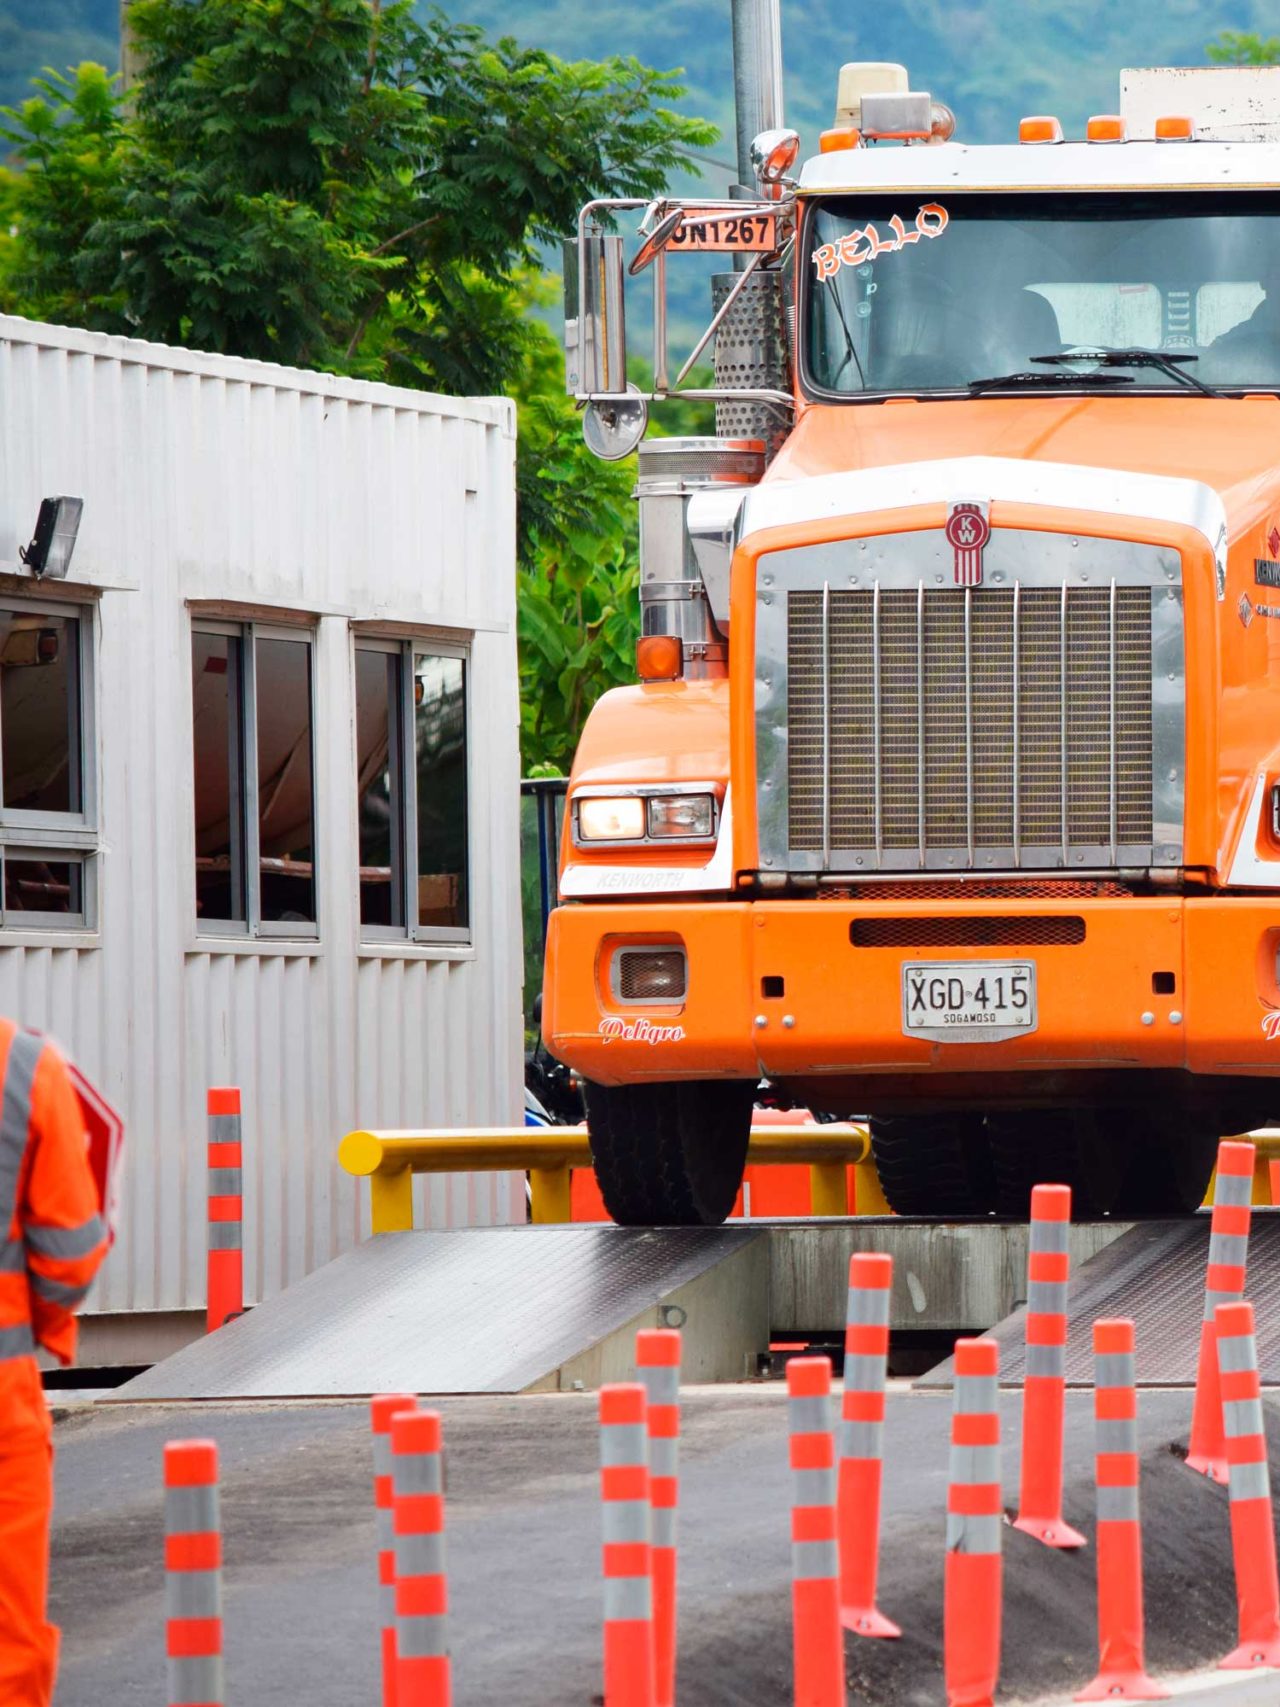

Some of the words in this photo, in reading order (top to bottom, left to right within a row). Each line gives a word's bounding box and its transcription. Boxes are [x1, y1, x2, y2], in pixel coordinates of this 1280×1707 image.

[672, 216, 769, 244] UN1267
[811, 202, 949, 282] BELLO
[596, 871, 686, 889] KENWORTH
[911, 978, 964, 1011] XGD
[973, 976, 1028, 1010] 415
[599, 1017, 686, 1046] Peligro
[943, 1012, 996, 1024] SOGAMOSO
